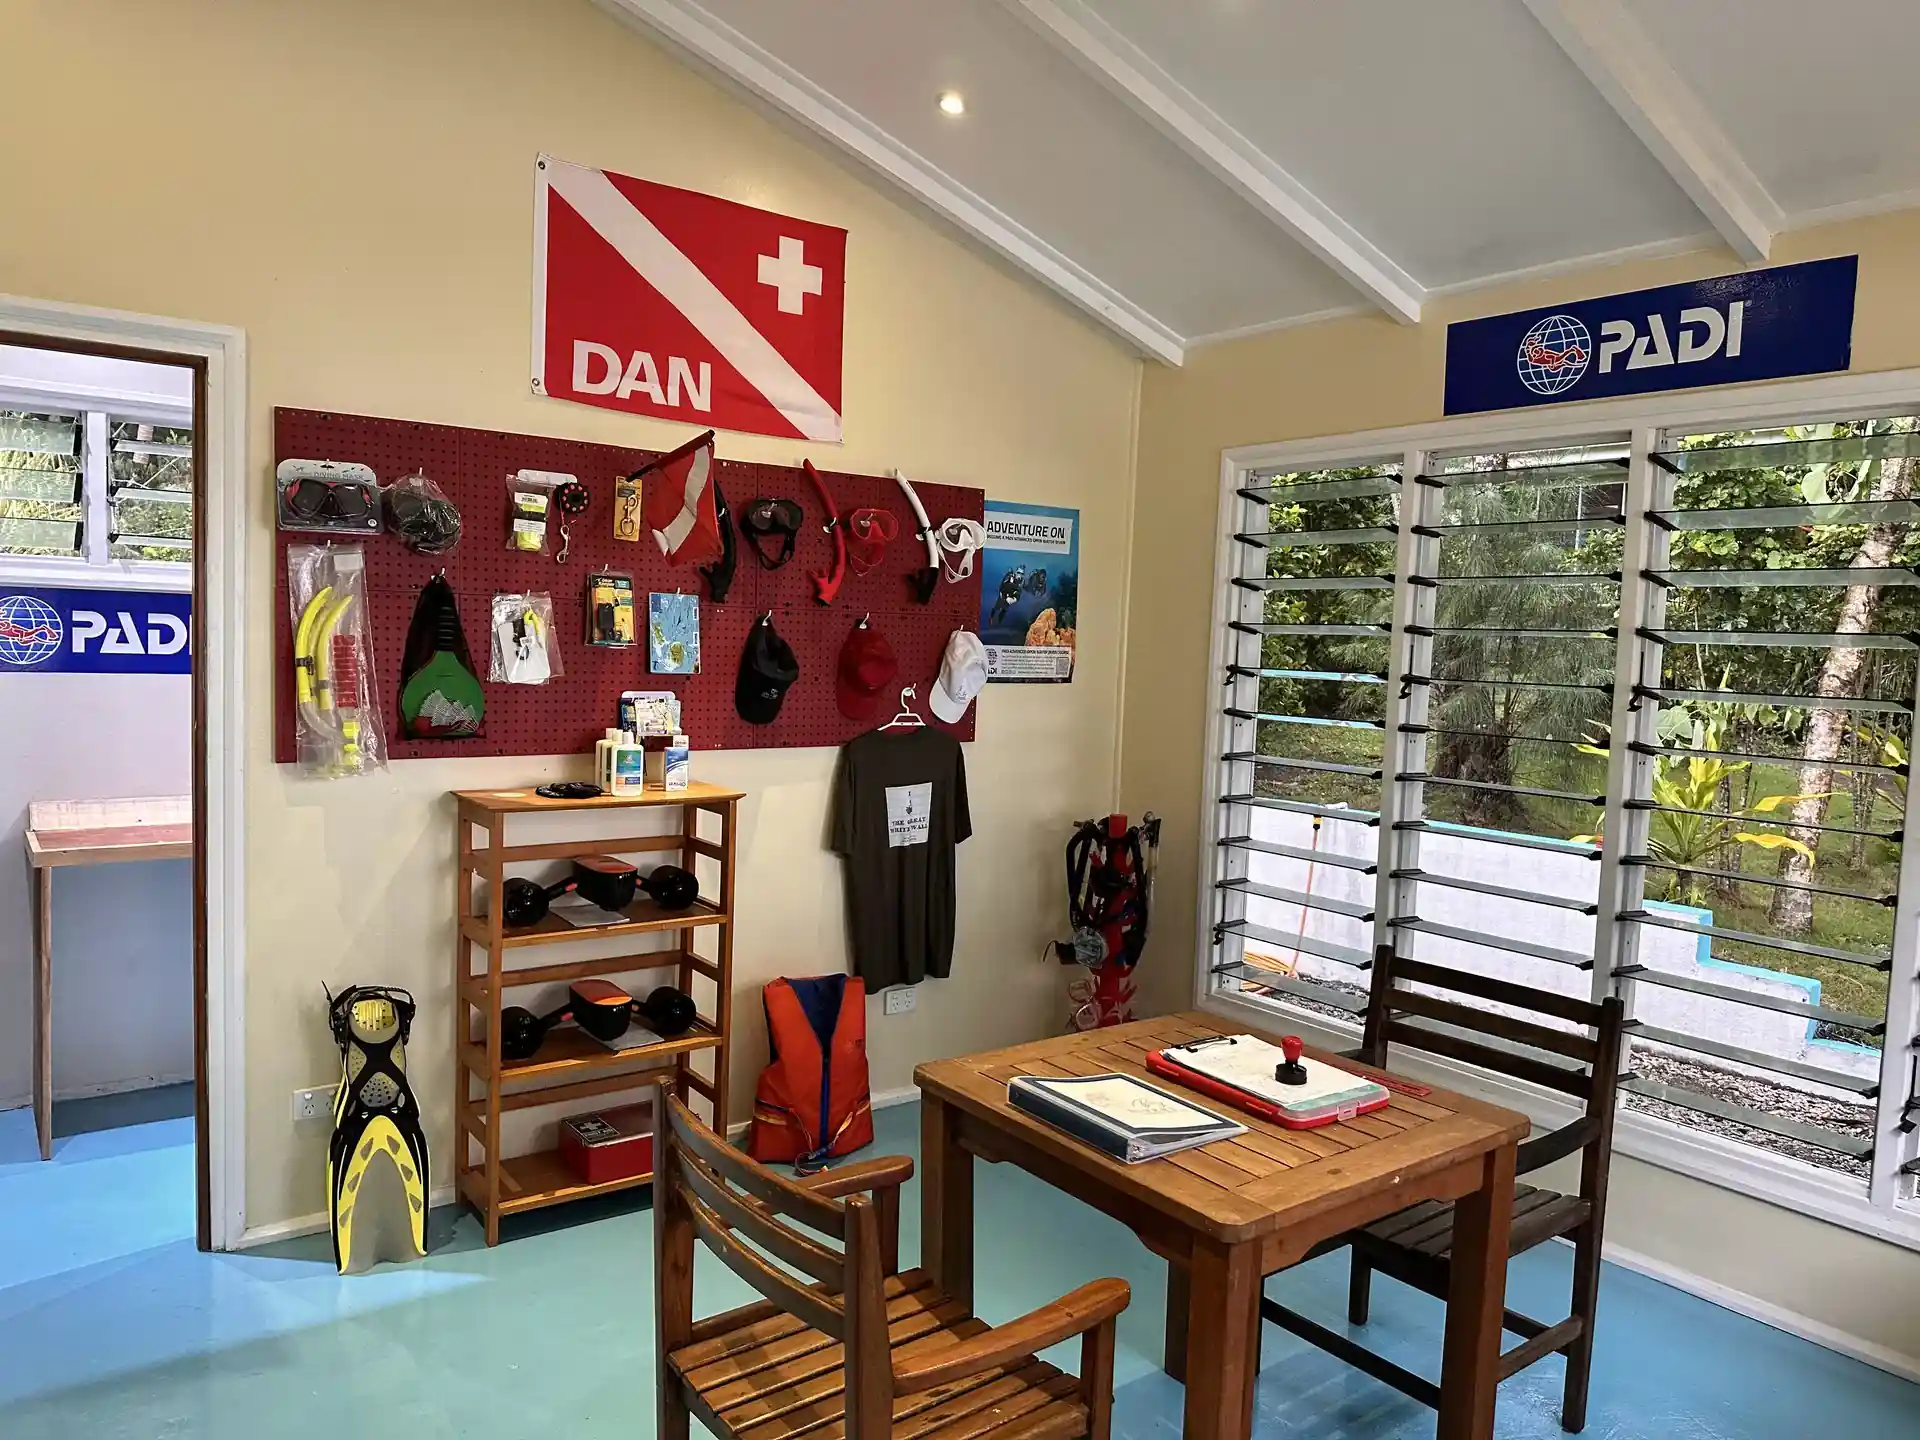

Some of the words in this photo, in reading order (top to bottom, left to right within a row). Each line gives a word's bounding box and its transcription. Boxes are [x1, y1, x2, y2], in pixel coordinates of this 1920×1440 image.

[1599, 301, 1744, 374] PADI
[572, 339, 711, 412] DAN
[987, 521, 1049, 538] ADVENTURE
[1050, 526, 1065, 539] ON
[72, 610, 193, 656] PAD
